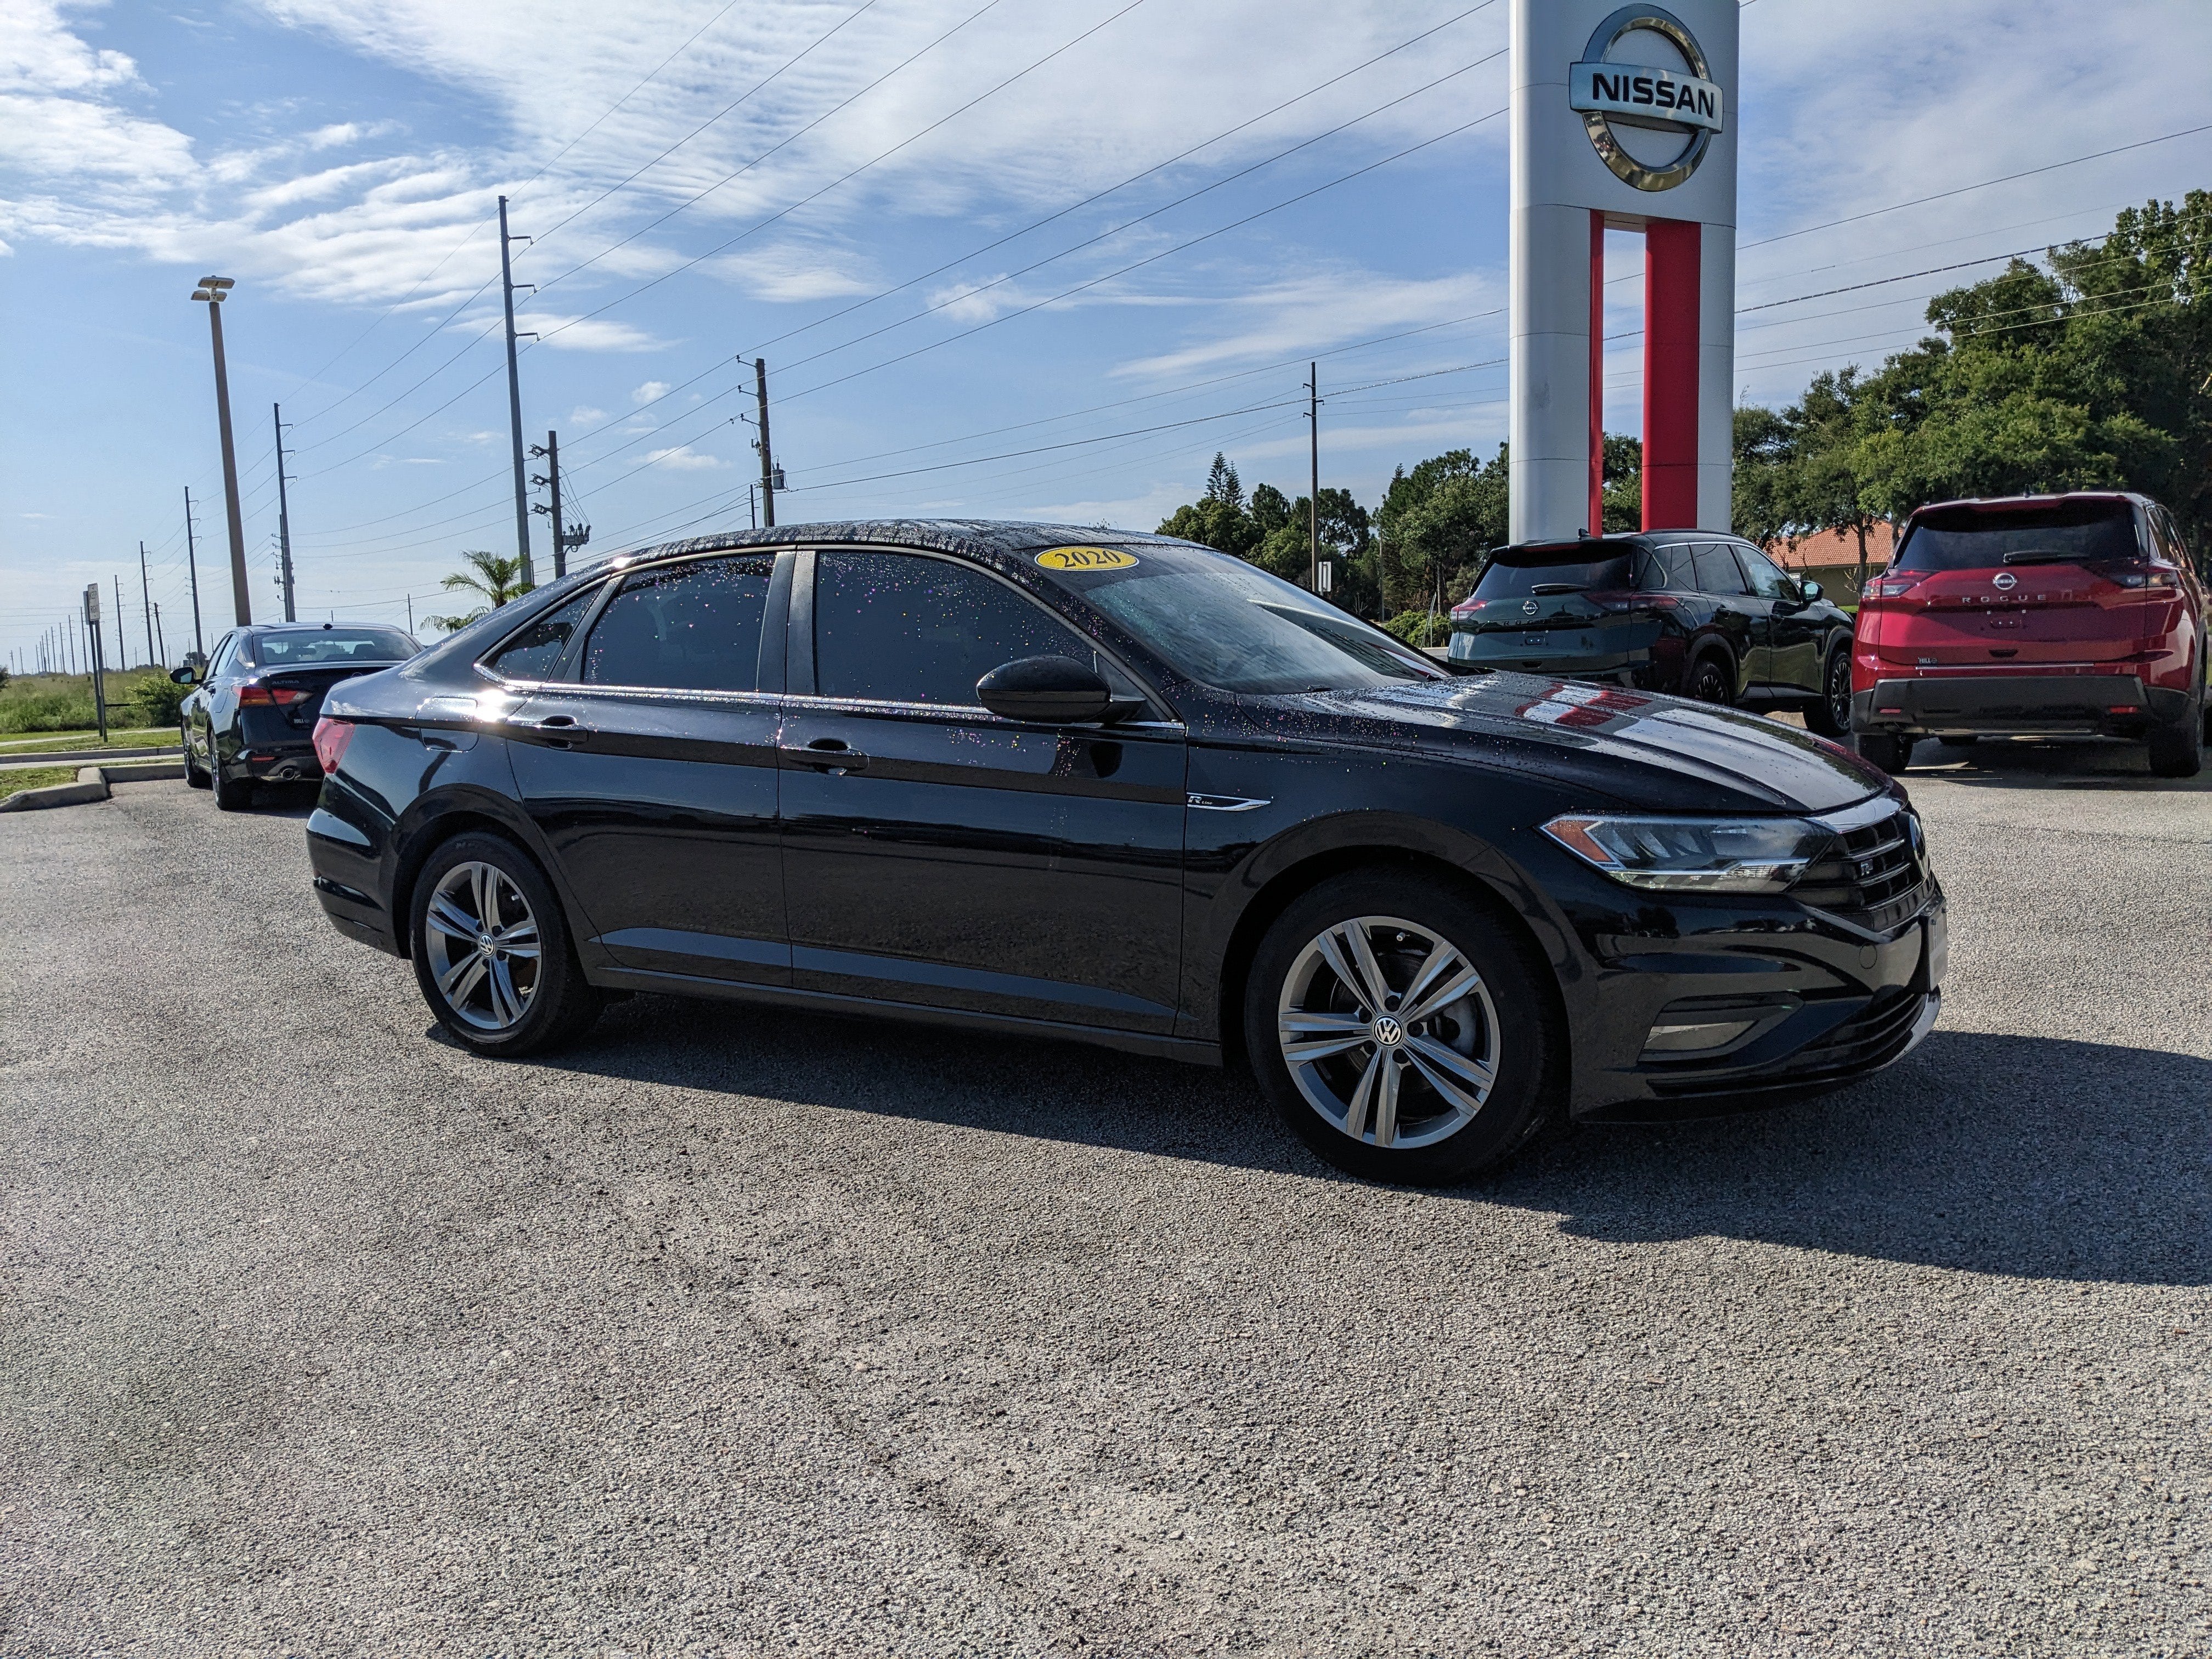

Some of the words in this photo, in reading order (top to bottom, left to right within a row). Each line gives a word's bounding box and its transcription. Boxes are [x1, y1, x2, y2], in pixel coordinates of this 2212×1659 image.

[1593, 73, 1714, 119] NISSAN
[1054, 550, 1121, 568] 2020
[1962, 594, 2046, 603] ROGUE
[1375, 1017, 1401, 1045] VW
